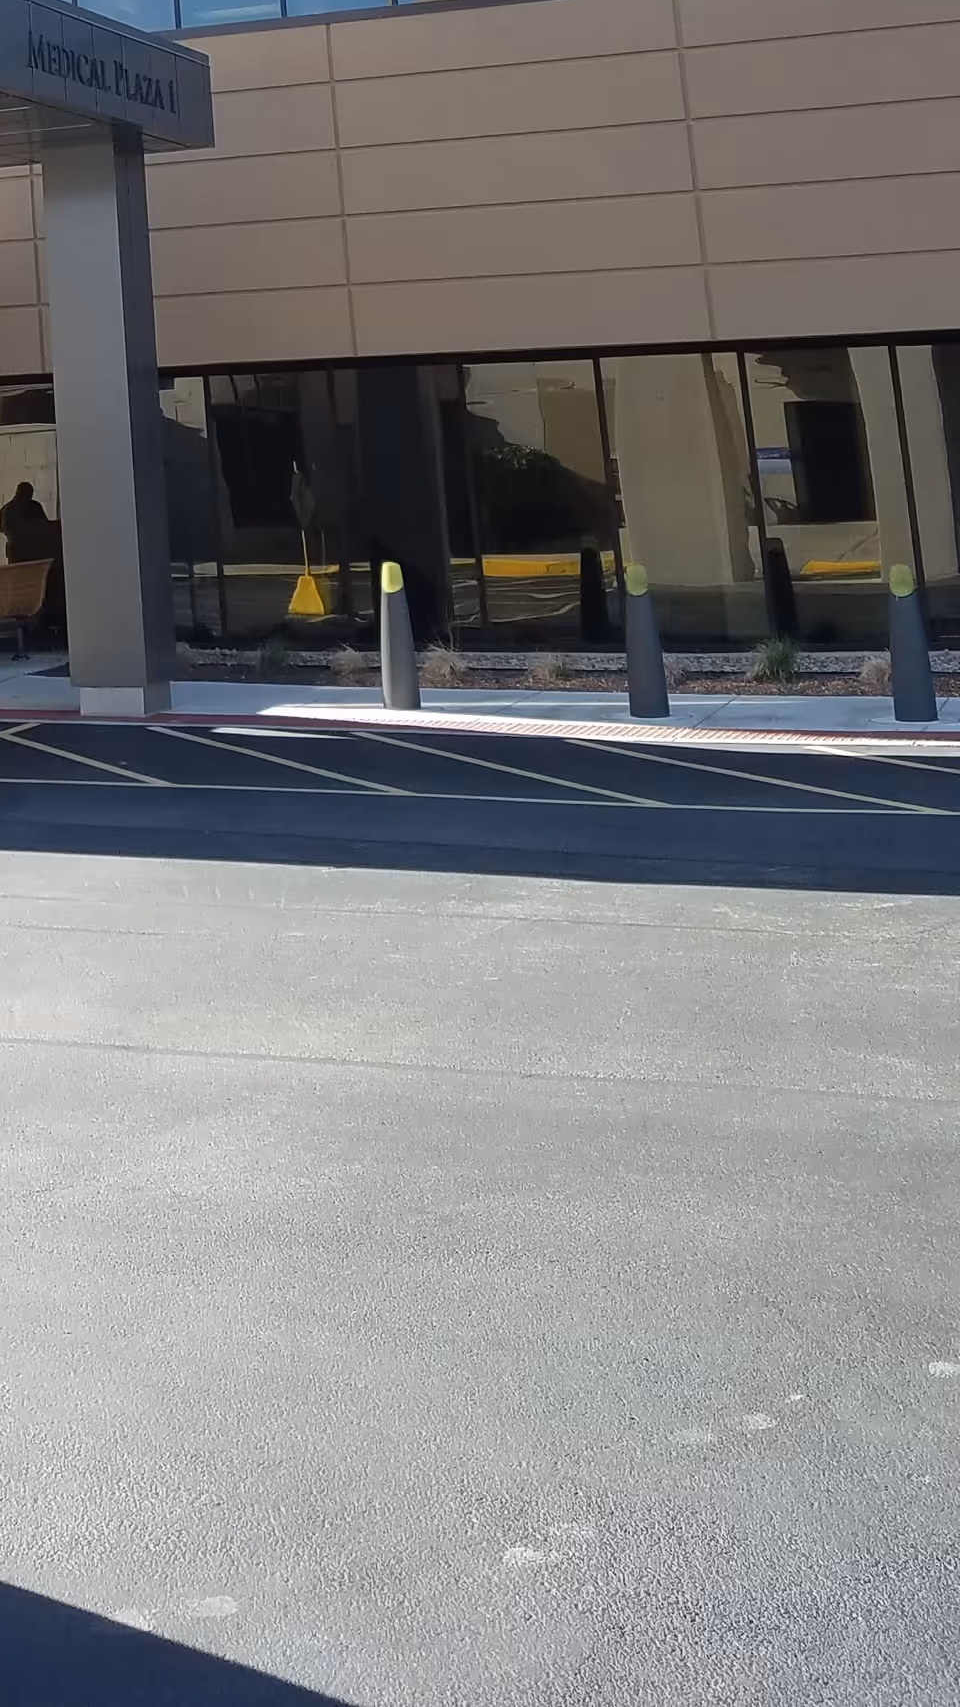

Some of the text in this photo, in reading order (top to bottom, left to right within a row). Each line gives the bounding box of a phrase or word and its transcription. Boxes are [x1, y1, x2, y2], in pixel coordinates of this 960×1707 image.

[26, 30, 176, 113] MEDICAL PLAZA 1
